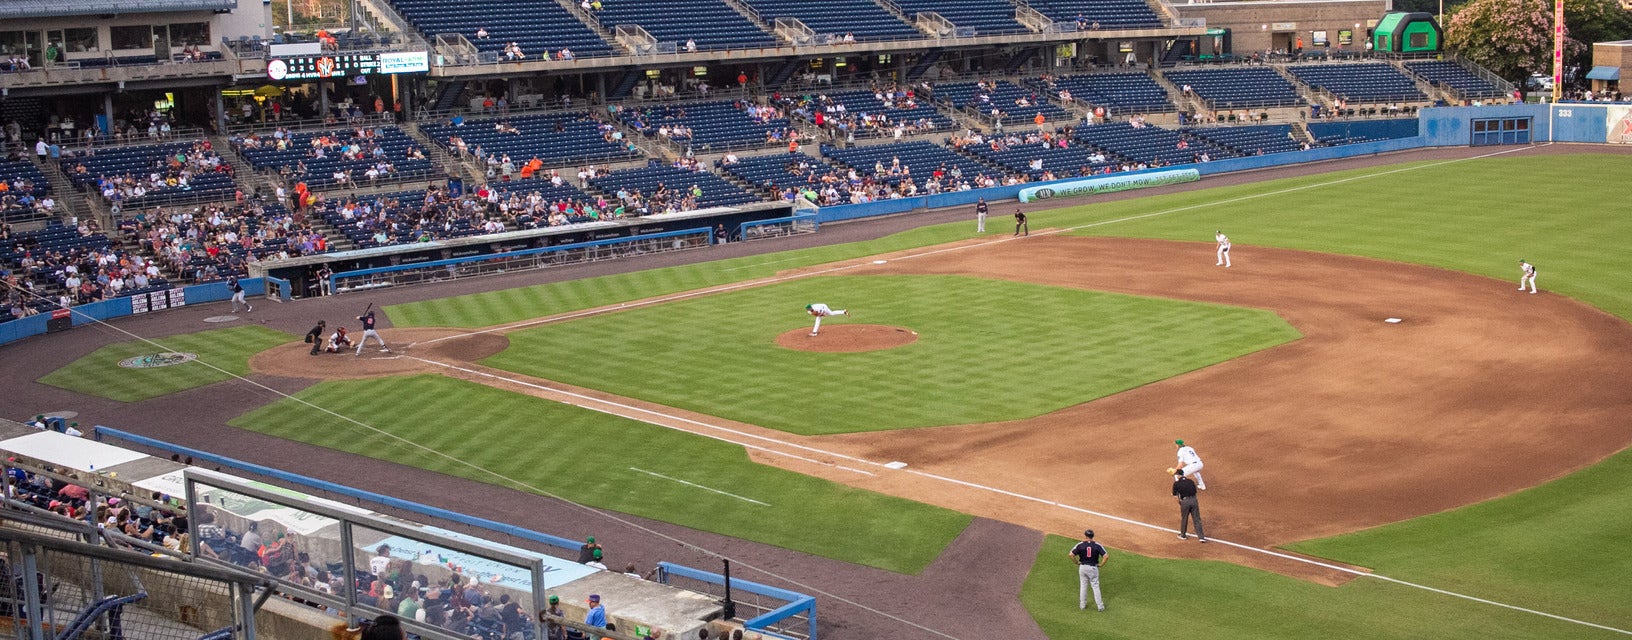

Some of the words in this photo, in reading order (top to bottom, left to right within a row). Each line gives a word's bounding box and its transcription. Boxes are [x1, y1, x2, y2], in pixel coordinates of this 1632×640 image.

[1558, 109, 1572, 118] 333
[1060, 188, 1071, 196] WE
[1098, 182, 1109, 190] WE
[1110, 180, 1131, 189] DON'T
